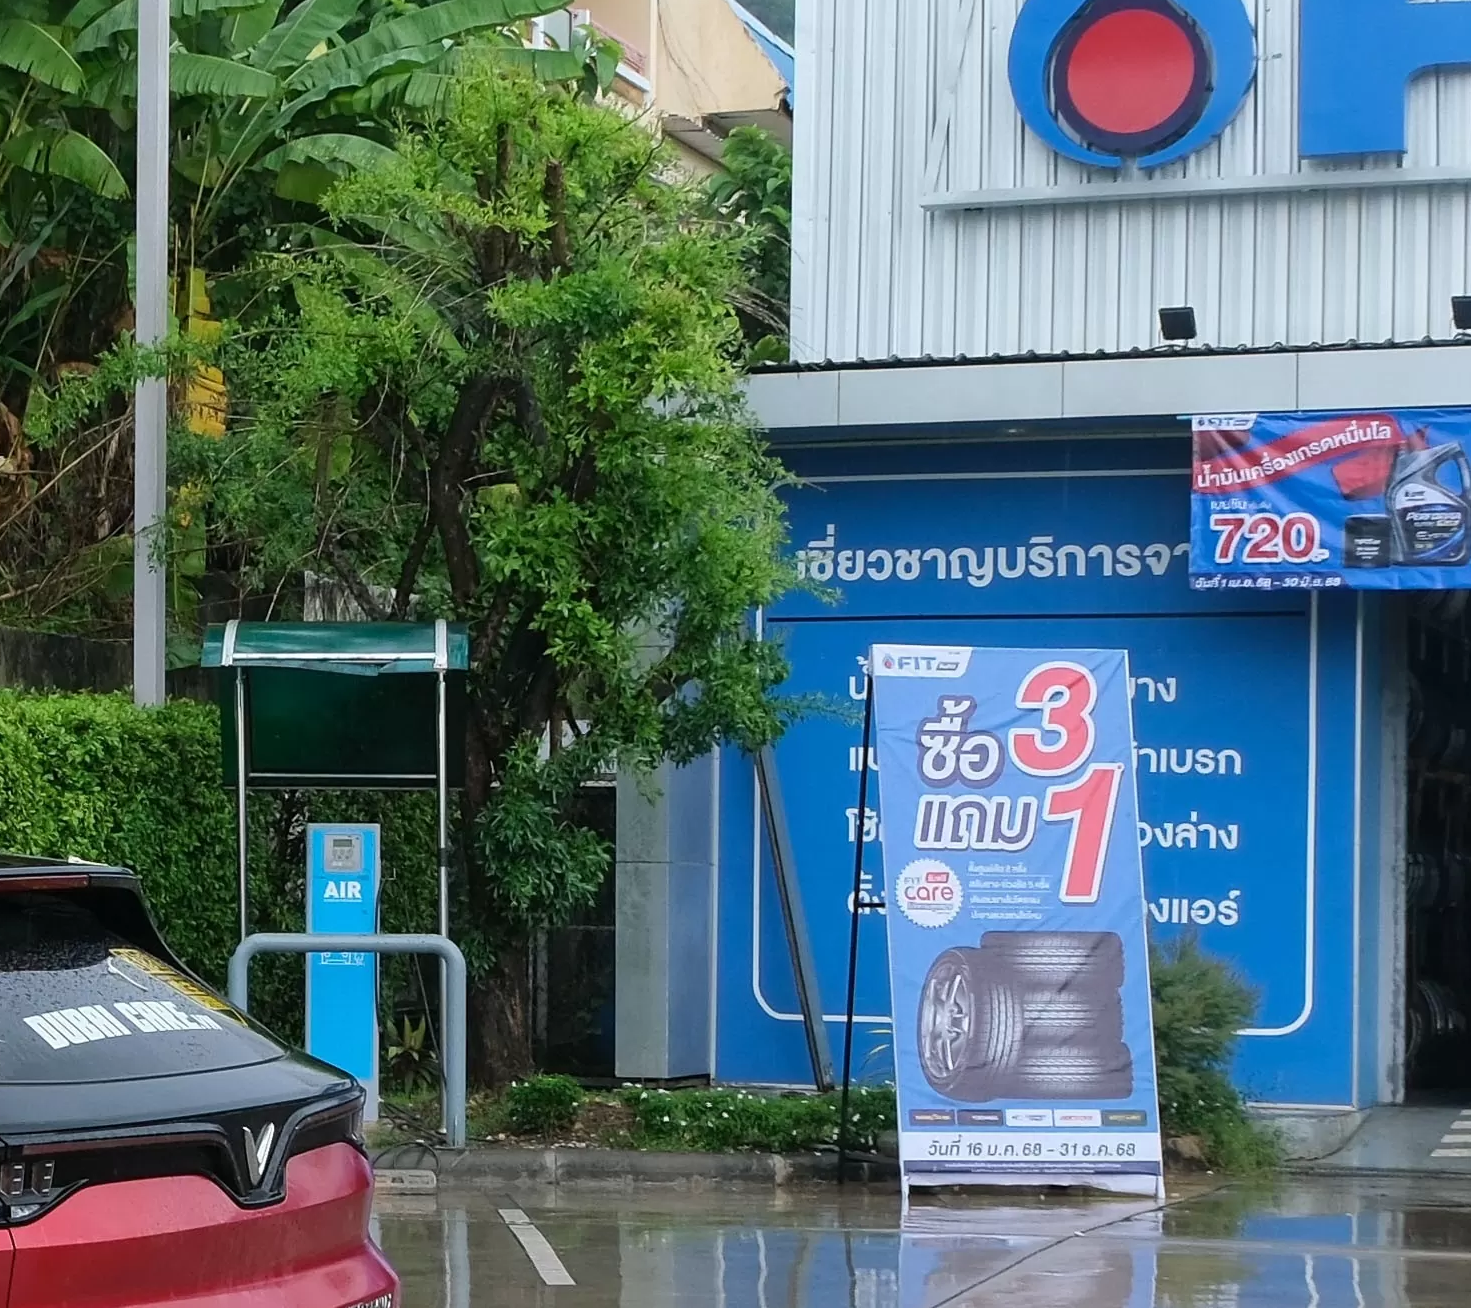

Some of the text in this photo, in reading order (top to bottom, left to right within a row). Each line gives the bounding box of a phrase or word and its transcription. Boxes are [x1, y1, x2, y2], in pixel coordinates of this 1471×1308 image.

[898, 656, 936, 671] FIT
[920, 698, 1001, 781] ซื้อ
[1008, 660, 1098, 777] 3
[913, 762, 1125, 903] แถม 1
[323, 880, 363, 899] AIR
[904, 884, 954, 902] care
[23, 1004, 132, 1050] DUBAI
[928, 1135, 961, 1157] วันที่
[966, 1143, 982, 1157] 16
[1022, 1143, 1042, 1157] 68
[1060, 1143, 1077, 1157] 31
[1117, 1143, 1136, 1157] 68
